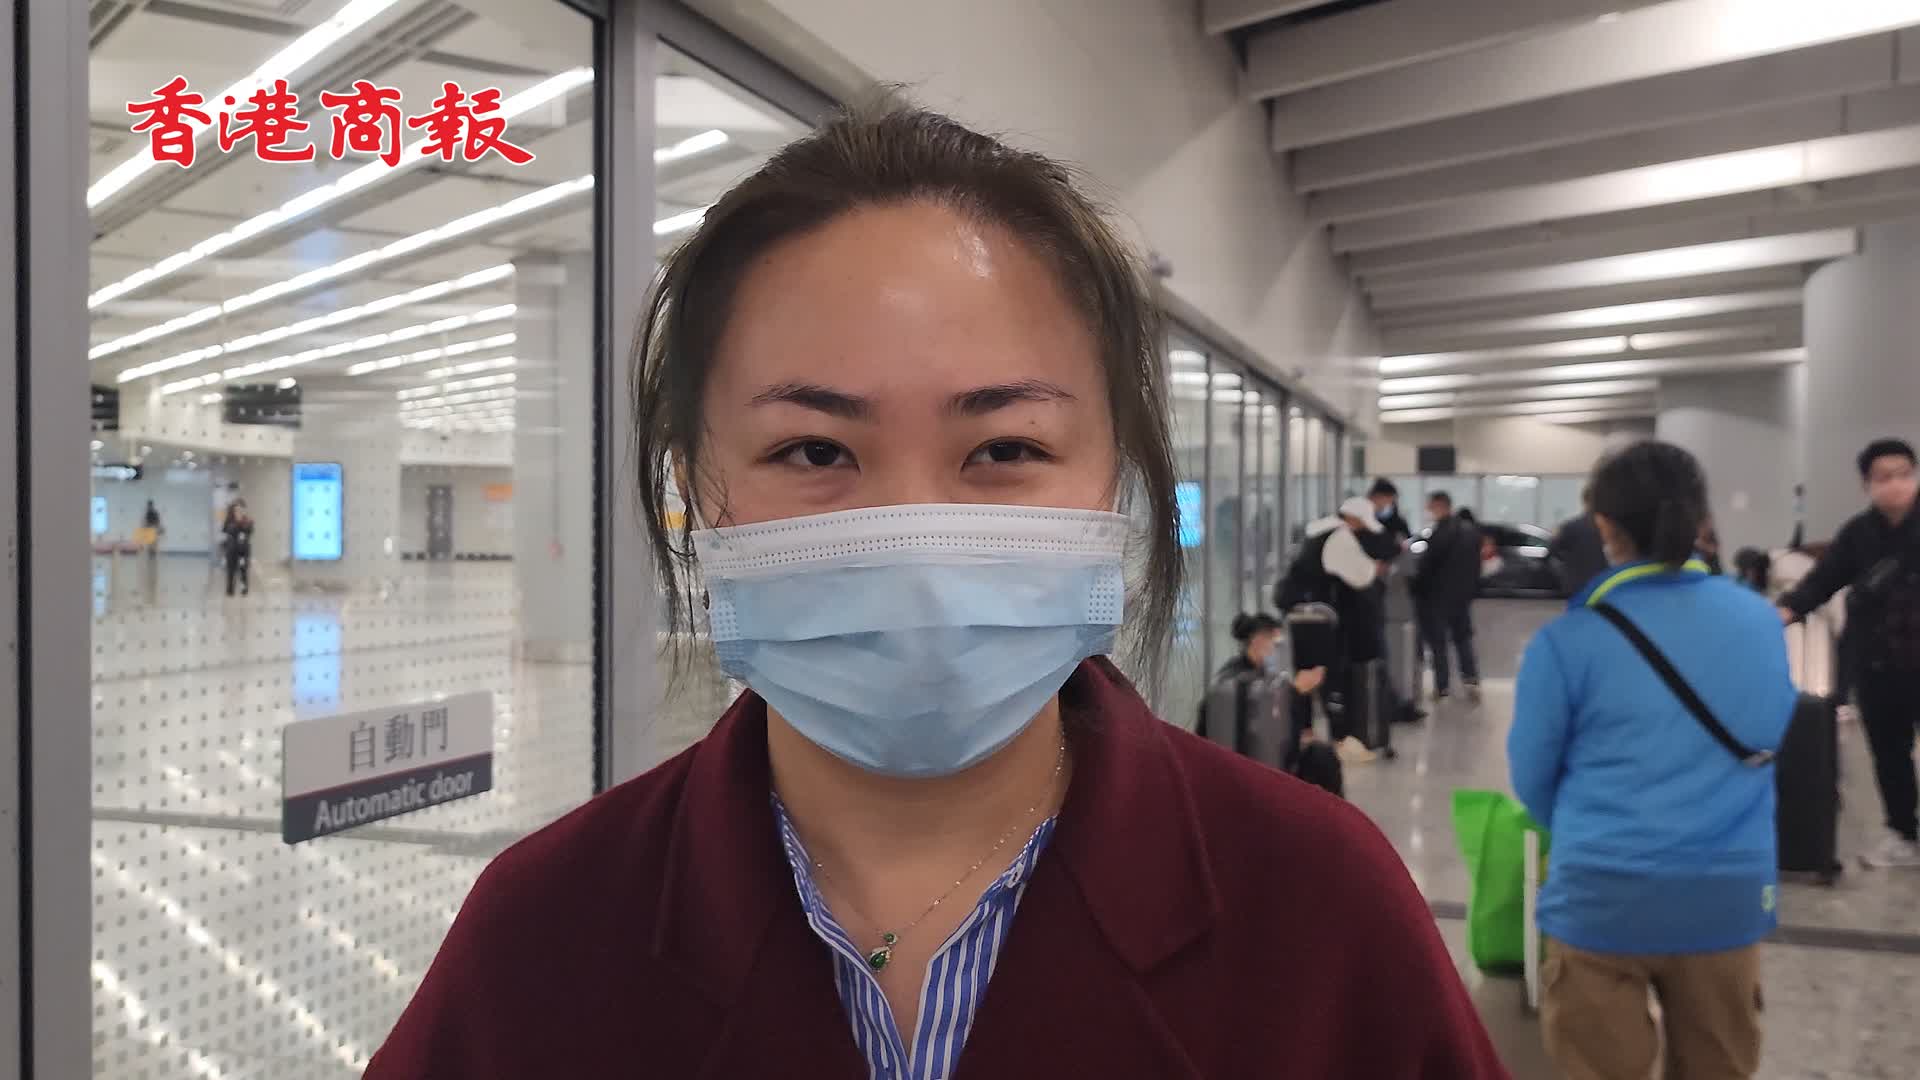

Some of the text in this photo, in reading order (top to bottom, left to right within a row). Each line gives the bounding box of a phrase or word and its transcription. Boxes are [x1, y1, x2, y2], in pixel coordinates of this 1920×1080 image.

[350, 706, 448, 772] 自動門
[314, 770, 475, 832] Automatic door
